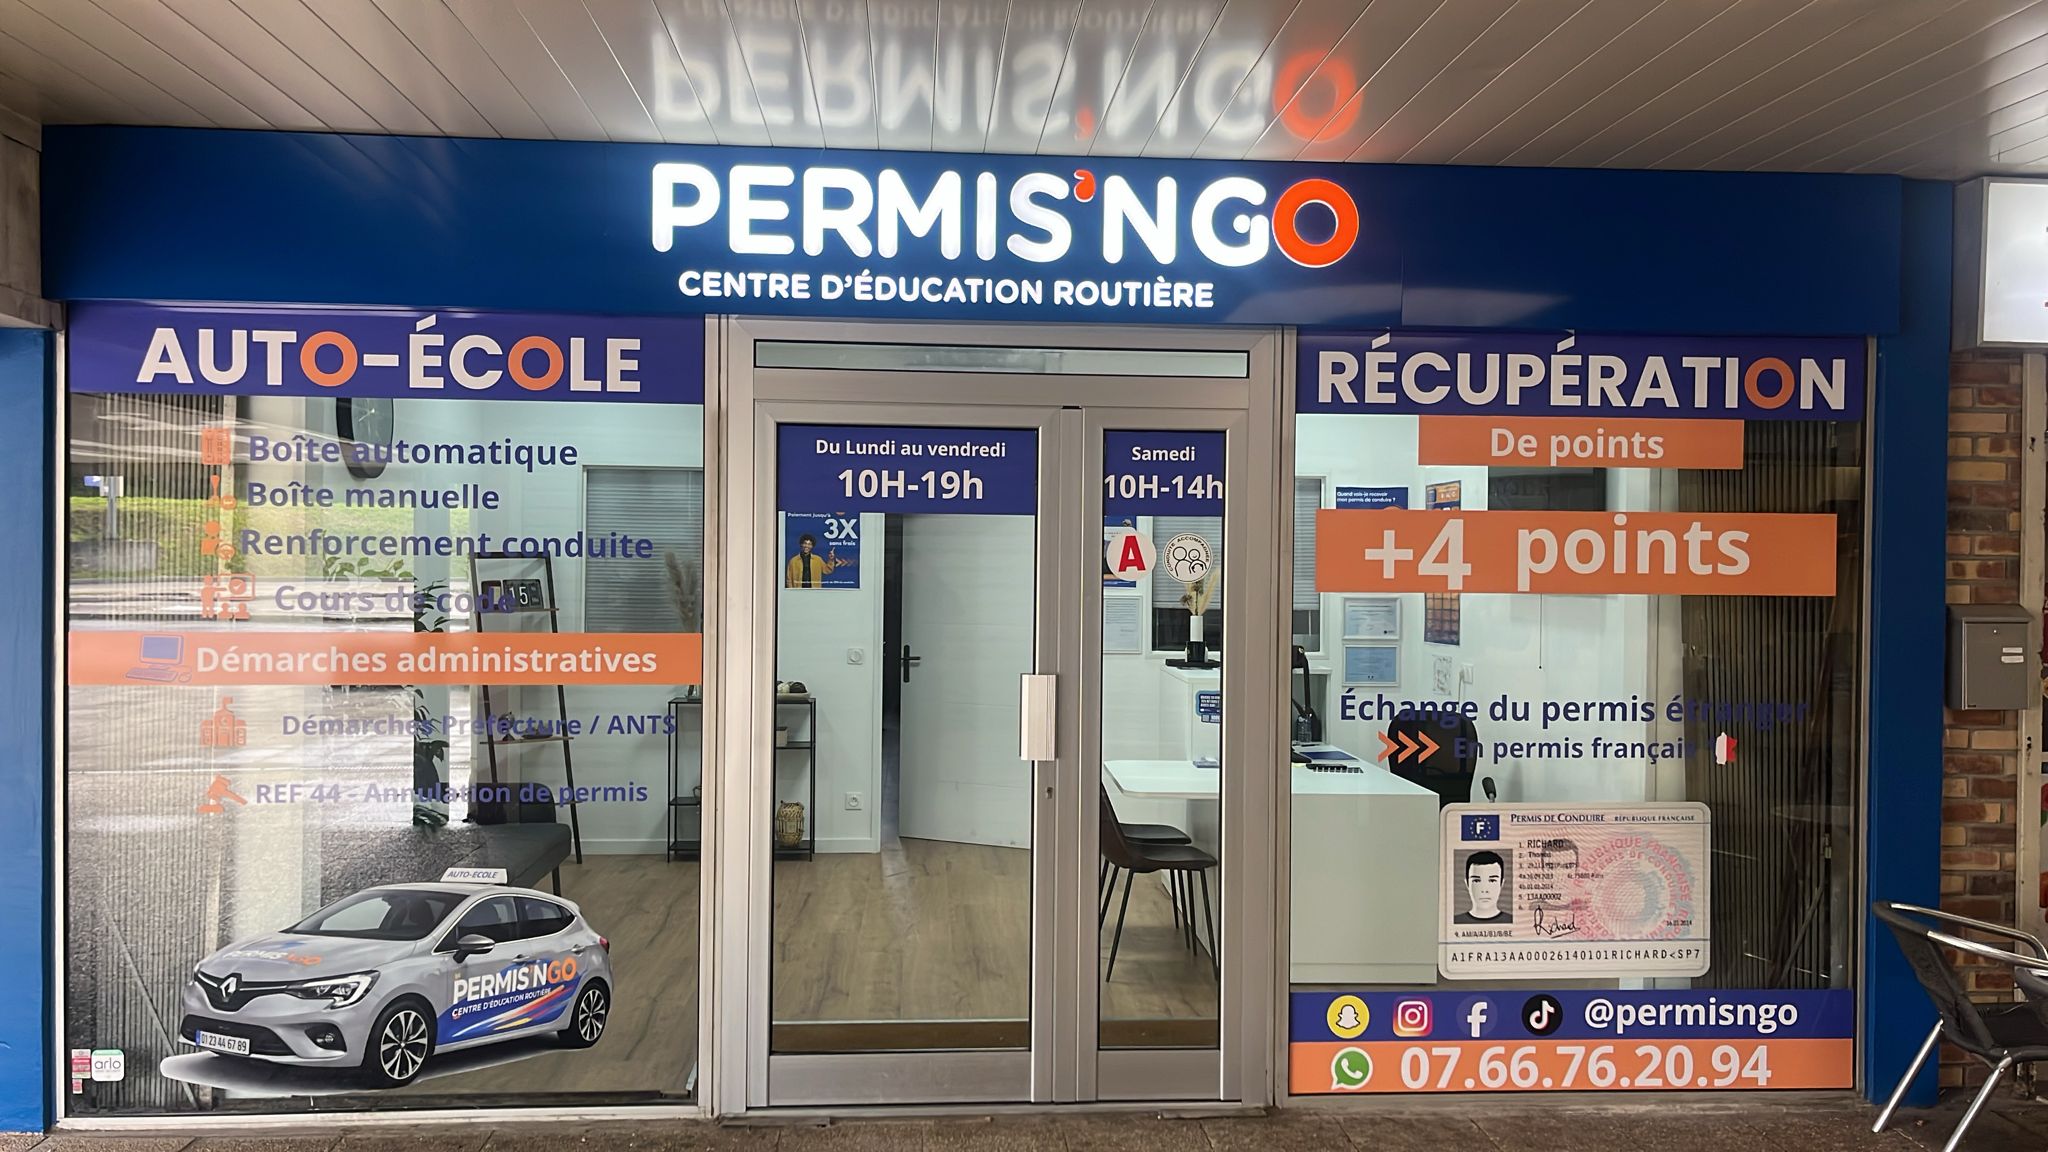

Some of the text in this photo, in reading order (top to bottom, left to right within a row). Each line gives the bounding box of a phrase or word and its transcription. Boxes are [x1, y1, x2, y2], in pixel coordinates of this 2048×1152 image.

[678, 267, 1215, 309] CENTRE D'ÉDUCATION ROUTIÈRE
[136, 313, 641, 393] AUTO-ÉCOLE
[1318, 331, 1847, 411] RÉCUPÉRATION
[249, 434, 578, 472] Boîte automatique
[815, 438, 1006, 458] Du Lundi au vendredi
[1131, 446, 1196, 462] Samedi
[1490, 427, 1664, 466] De points
[247, 480, 500, 510] Boîte manuelle
[837, 468, 984, 500] 10H-19h
[1104, 474, 1224, 500] 10H-14h
[240, 527, 654, 560] Renforcement conduite
[823, 518, 858, 539] 3X
[1118, 535, 1146, 572] A
[1364, 513, 1751, 592] +4 points
[275, 584, 517, 613] Cours de code
[197, 644, 658, 674] Démarches administratives
[282, 713, 434, 737] Démarches
[606, 714, 677, 736] ANTS
[1340, 688, 1810, 732] Échange du permis étranger
[1454, 736, 1484, 759] En
[1492, 736, 1584, 765] permis
[255, 785, 305, 804] REF
[311, 784, 341, 804] 44
[364, 782, 512, 804] Annulation
[519, 782, 551, 804] de
[558, 781, 648, 808] permis
[1475, 823, 1486, 834] F
[1510, 812, 1605, 823] PERMIS DE CONDUIRE
[1527, 839, 1564, 849] RICHARD
[451, 1001, 482, 1018] CENTRE
[483, 992, 525, 1011] D'ÉDUCATION
[1584, 998, 1798, 1034] @permisngo
[94, 1056, 121, 1070] arlo
[1400, 1045, 1772, 1089] 07.66.76.20.94
